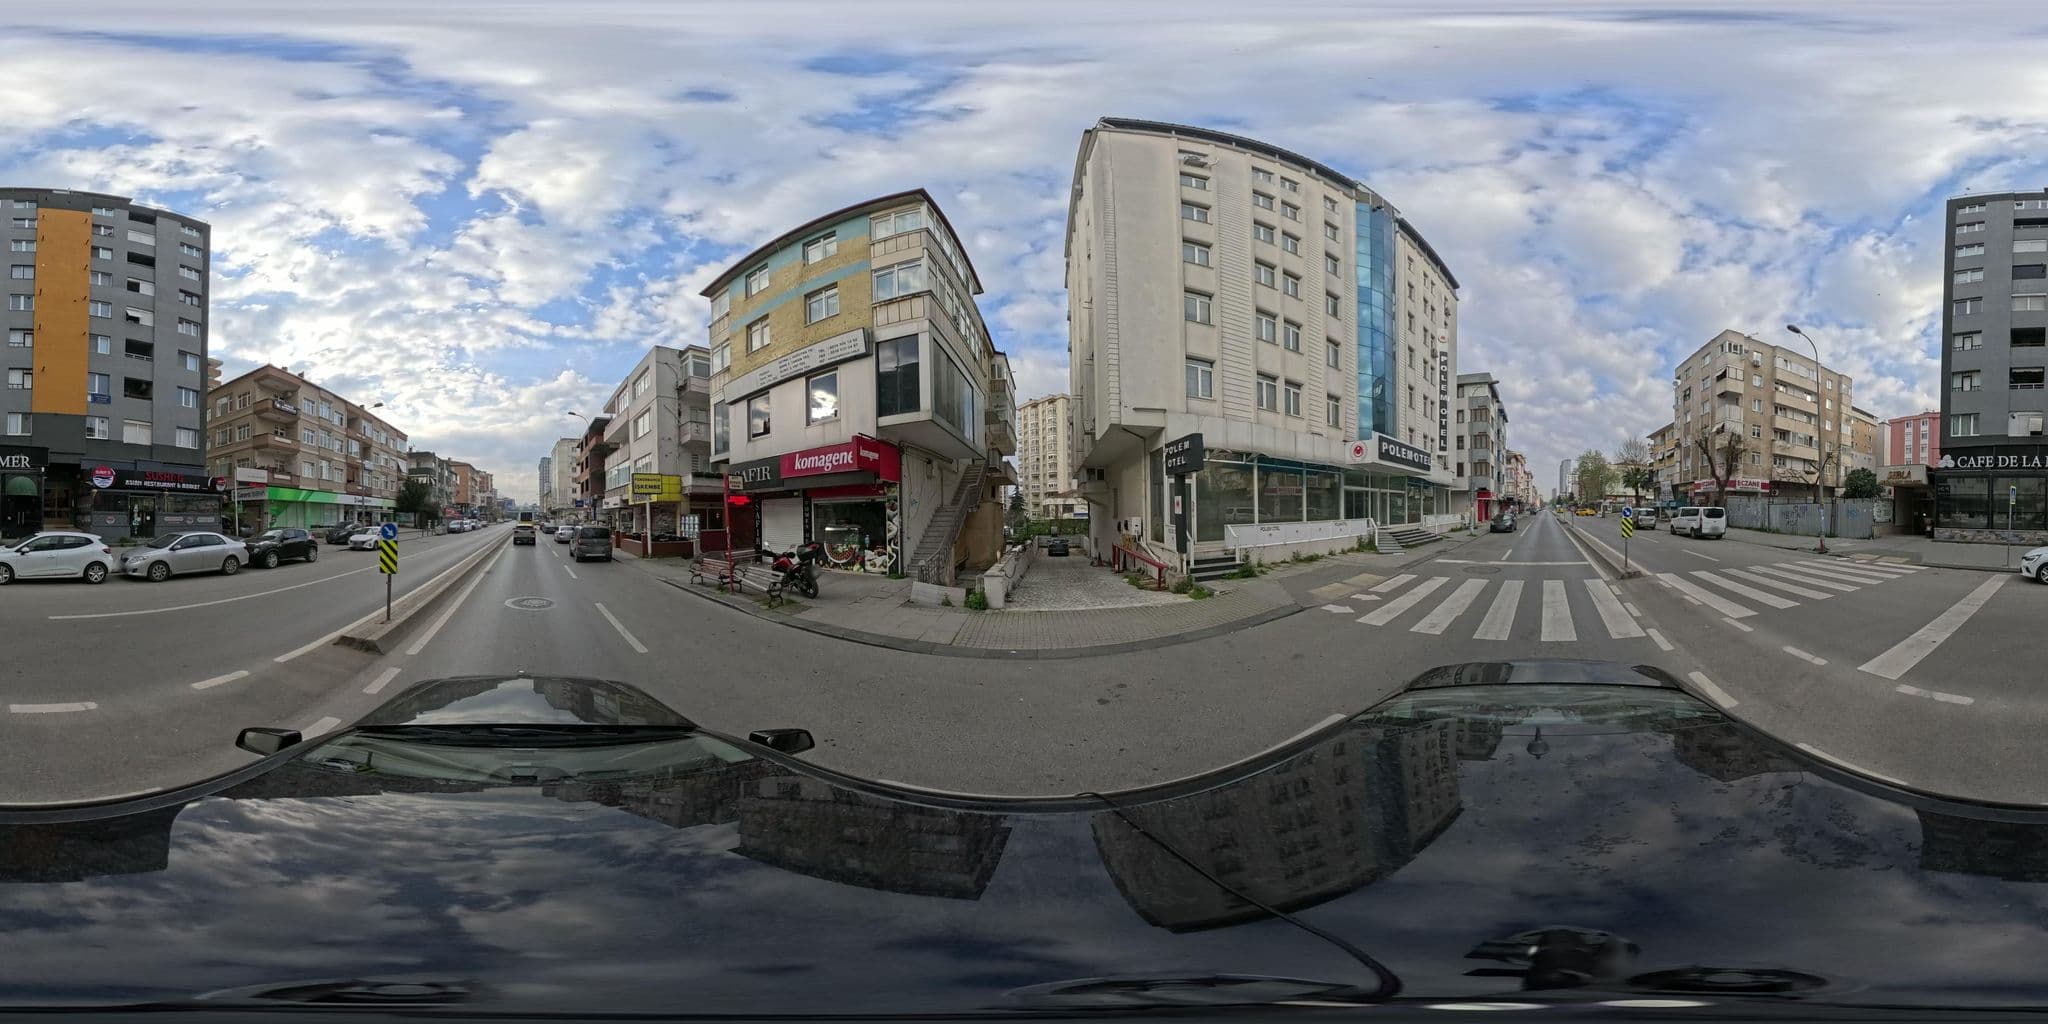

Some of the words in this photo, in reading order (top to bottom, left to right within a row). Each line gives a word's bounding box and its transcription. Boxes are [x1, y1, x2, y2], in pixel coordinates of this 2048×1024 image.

[1440, 355, 1449, 401] POLEM
[1168, 455, 1186, 467] OTEL
[1957, 456, 1994, 468] CAFE
[1997, 456, 2018, 468] DE
[2022, 456, 2042, 468] LA
[1738, 480, 1760, 488] ECZANE
